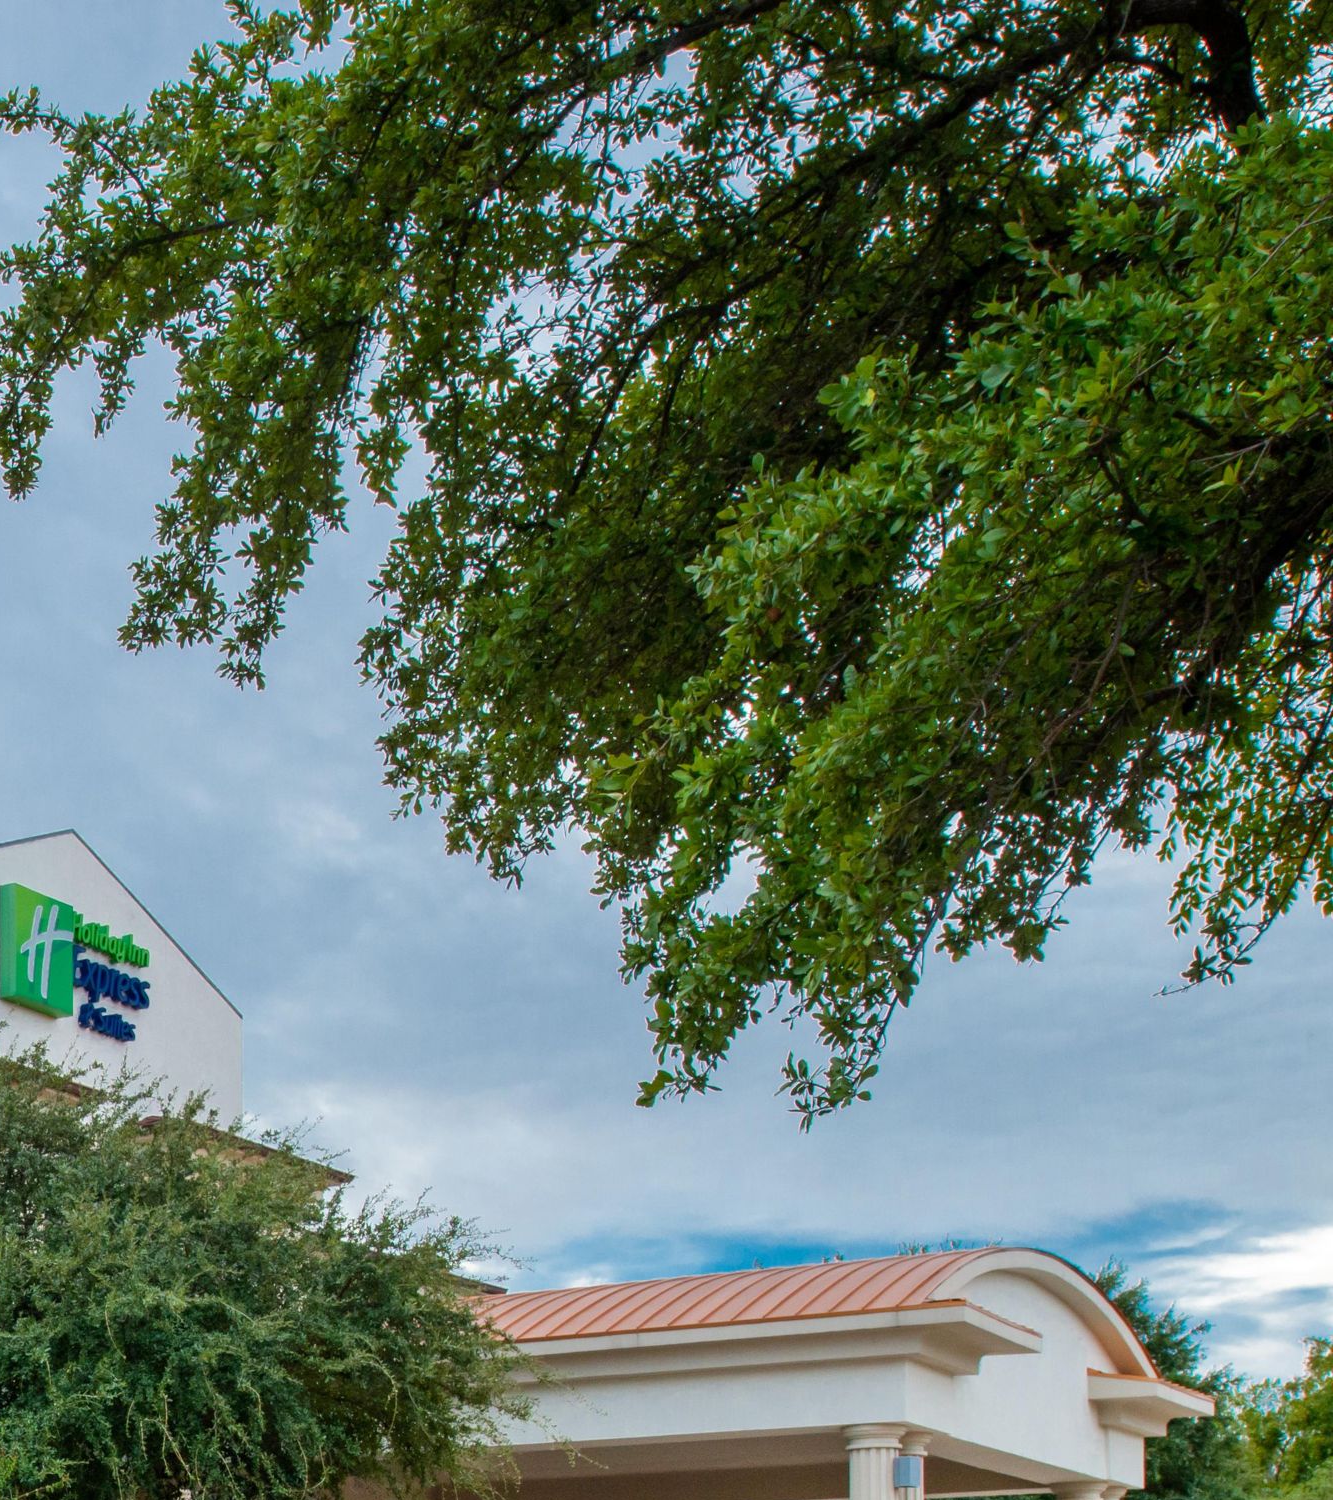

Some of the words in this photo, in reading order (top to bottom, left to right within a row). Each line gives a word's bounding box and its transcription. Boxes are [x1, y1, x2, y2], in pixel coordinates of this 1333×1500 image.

[73, 911, 129, 965] Holiday
[123, 934, 150, 968] Inn
[73, 944, 151, 1010] Express
[91, 1007, 137, 1042] Suites
